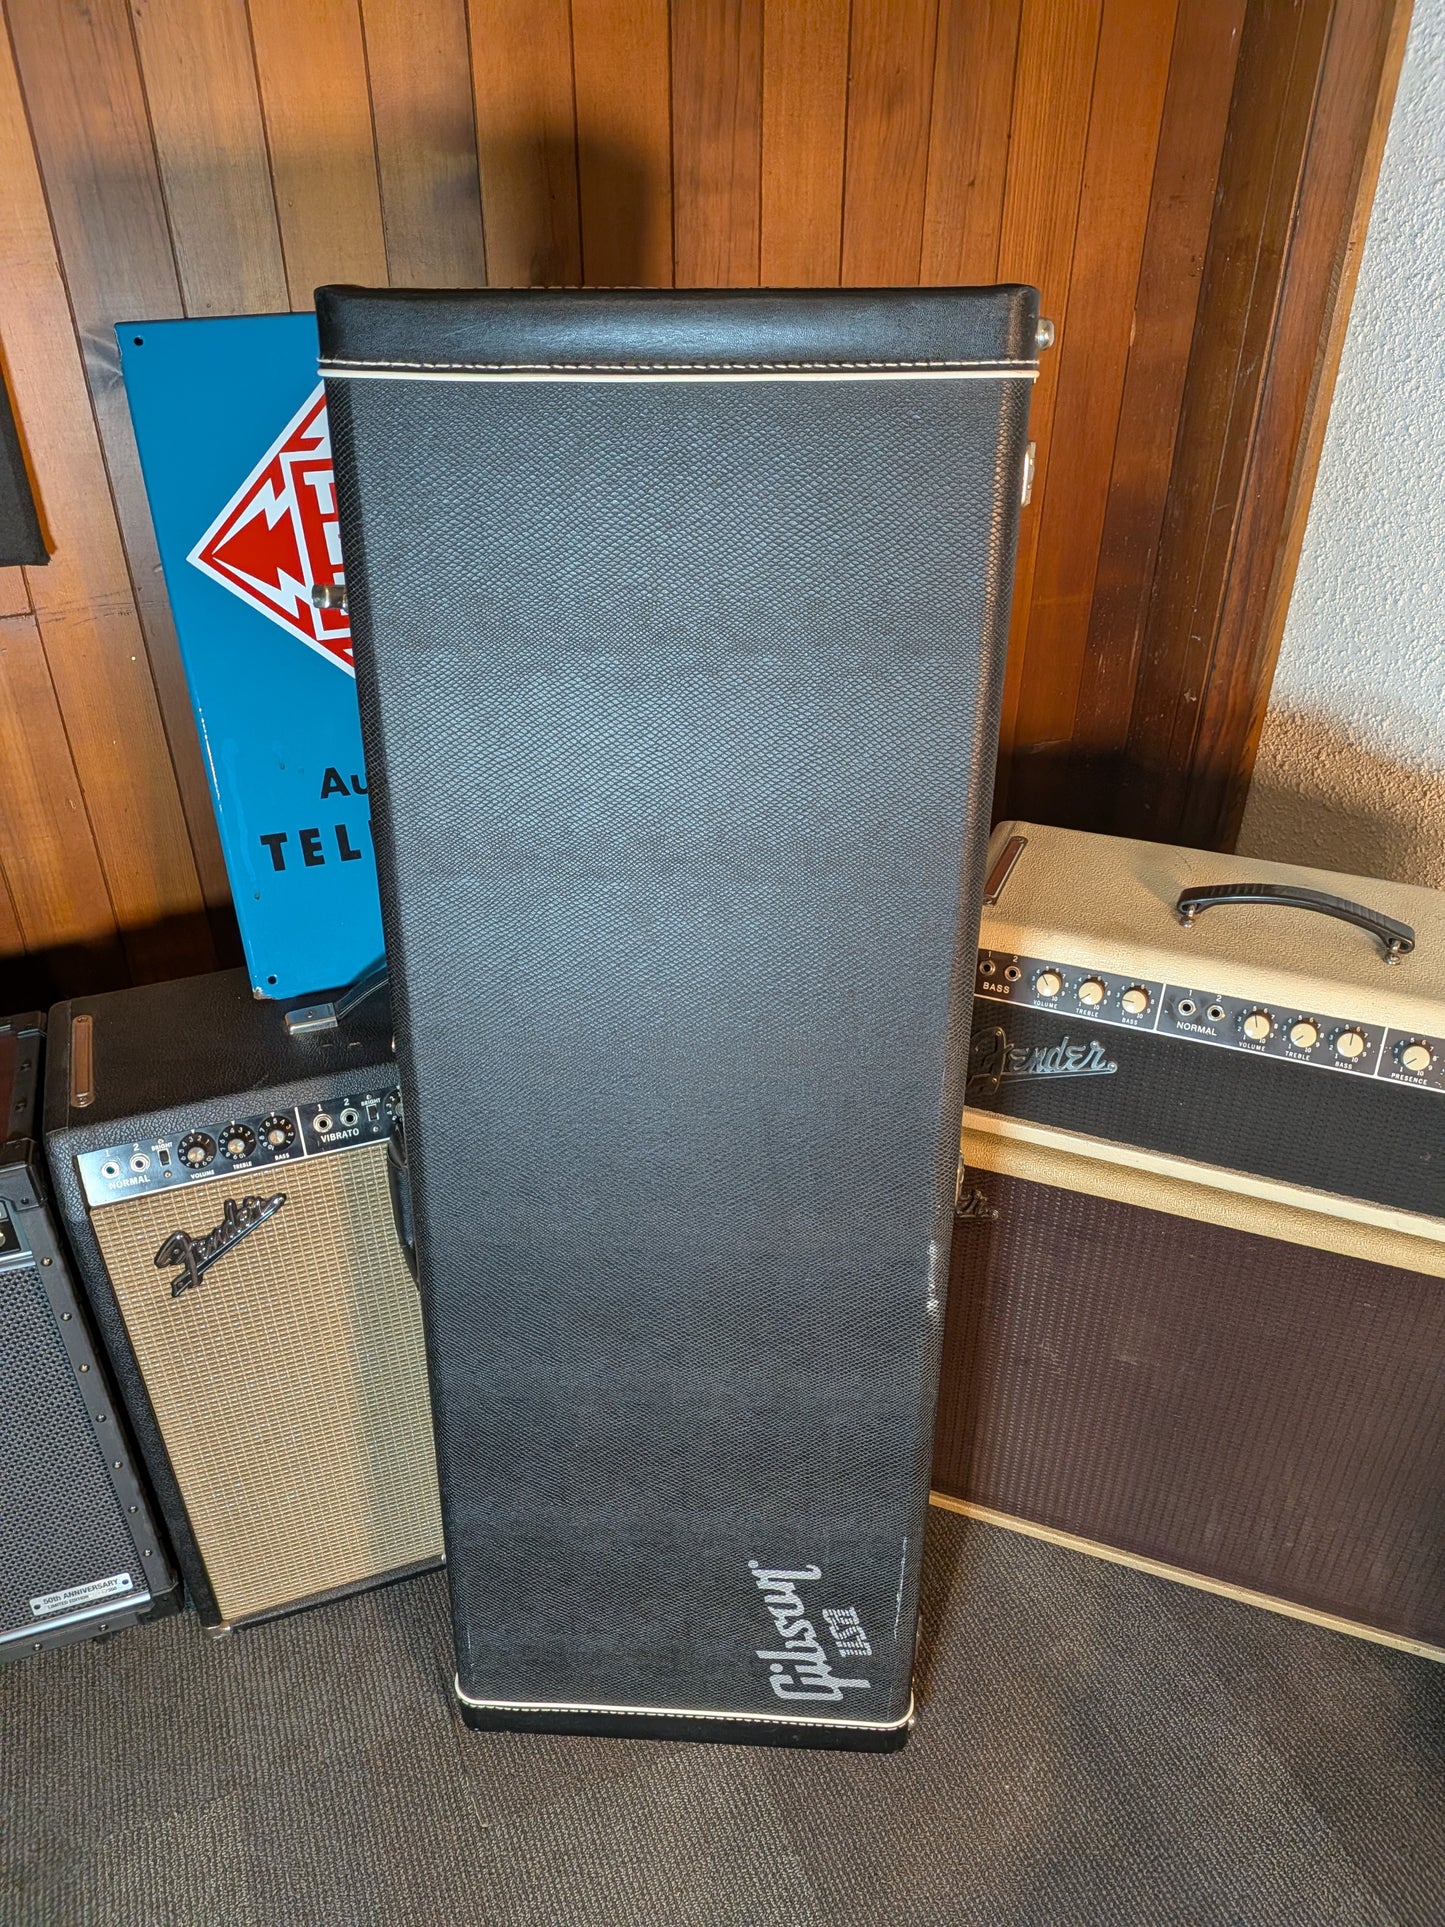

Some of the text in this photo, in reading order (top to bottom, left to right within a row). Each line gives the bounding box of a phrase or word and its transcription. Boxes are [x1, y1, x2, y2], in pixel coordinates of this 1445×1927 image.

[260, 820, 371, 871] TEL
[983, 982, 1010, 993] BASS
[1034, 1000, 1058, 1008] VOLUME
[1076, 1008, 1099, 1017] TREBLE
[1177, 1021, 1217, 1036] NORMAL
[1239, 1042, 1265, 1051] VOLUME
[968, 1026, 1117, 1097] Fender
[1285, 1051, 1310, 1061] TREBLE
[1335, 1061, 1352, 1069] BASS
[1391, 1073, 1427, 1085] PRESENCE
[344, 1098, 350, 1106] 2
[361, 1098, 381, 1106] BRIGHT
[321, 1128, 359, 1143] VIBRATO
[133, 1143, 139, 1151] 2
[151, 1142, 172, 1151] BRIGHT
[233, 1161, 252, 1170] TREBLE
[190, 1169, 215, 1179] VOLUME
[109, 1175, 150, 1189] NORMAL
[154, 1192, 287, 1298] Fender
[43, 1595, 61, 1604] 50th
[63, 1579, 118, 1599] ANNIVERSARY
[47, 1595, 89, 1610] LIMITED EDITION
[748, 1560, 871, 1700] Gibson
[822, 1607, 872, 1657] USA
